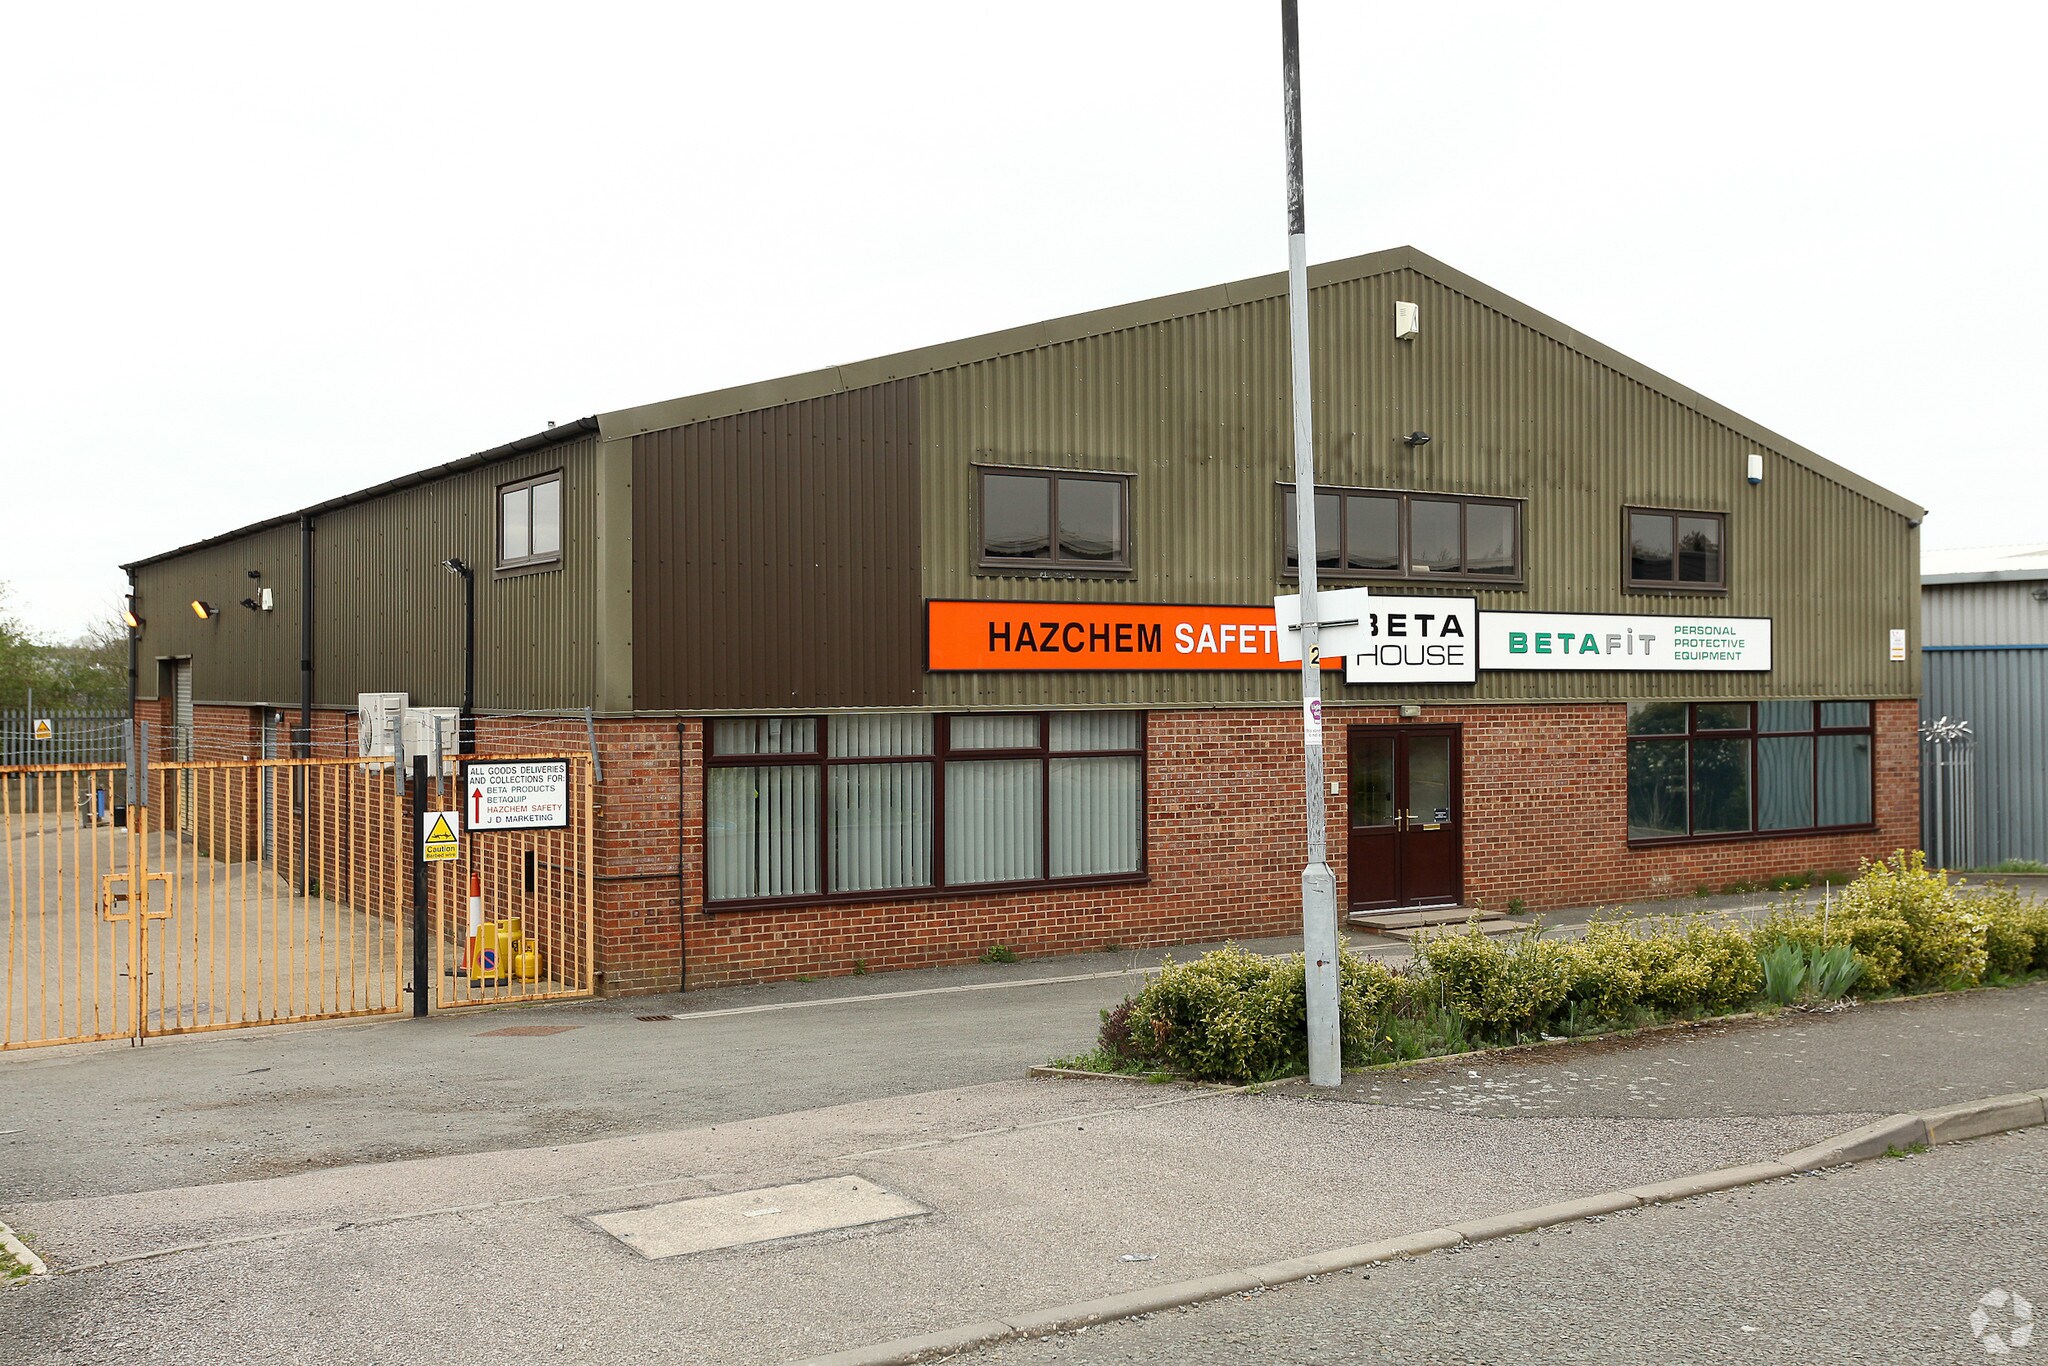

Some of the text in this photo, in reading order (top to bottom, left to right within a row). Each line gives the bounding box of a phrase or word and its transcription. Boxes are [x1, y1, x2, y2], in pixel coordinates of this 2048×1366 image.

[1674, 625, 1736, 636] PERSONAL
[988, 621, 1277, 655] HAZCHEM SAFET
[1674, 638, 1746, 649] PROTECTIVE
[1310, 646, 1320, 664] 2
[1356, 644, 1465, 666] HOUSE
[1674, 651, 1742, 661] EQUIPMENT
[470, 764, 565, 775] ALL GOODS DELIVERIES
[469, 774, 565, 785] AND COLLECTIONS FOR:
[486, 784, 556, 794] BETA PRODUCTS
[486, 795, 527, 804] BETAQUIP
[486, 803, 562, 813] HAZCHEM SAFETY
[486, 813, 553, 824] J D MARKETING
